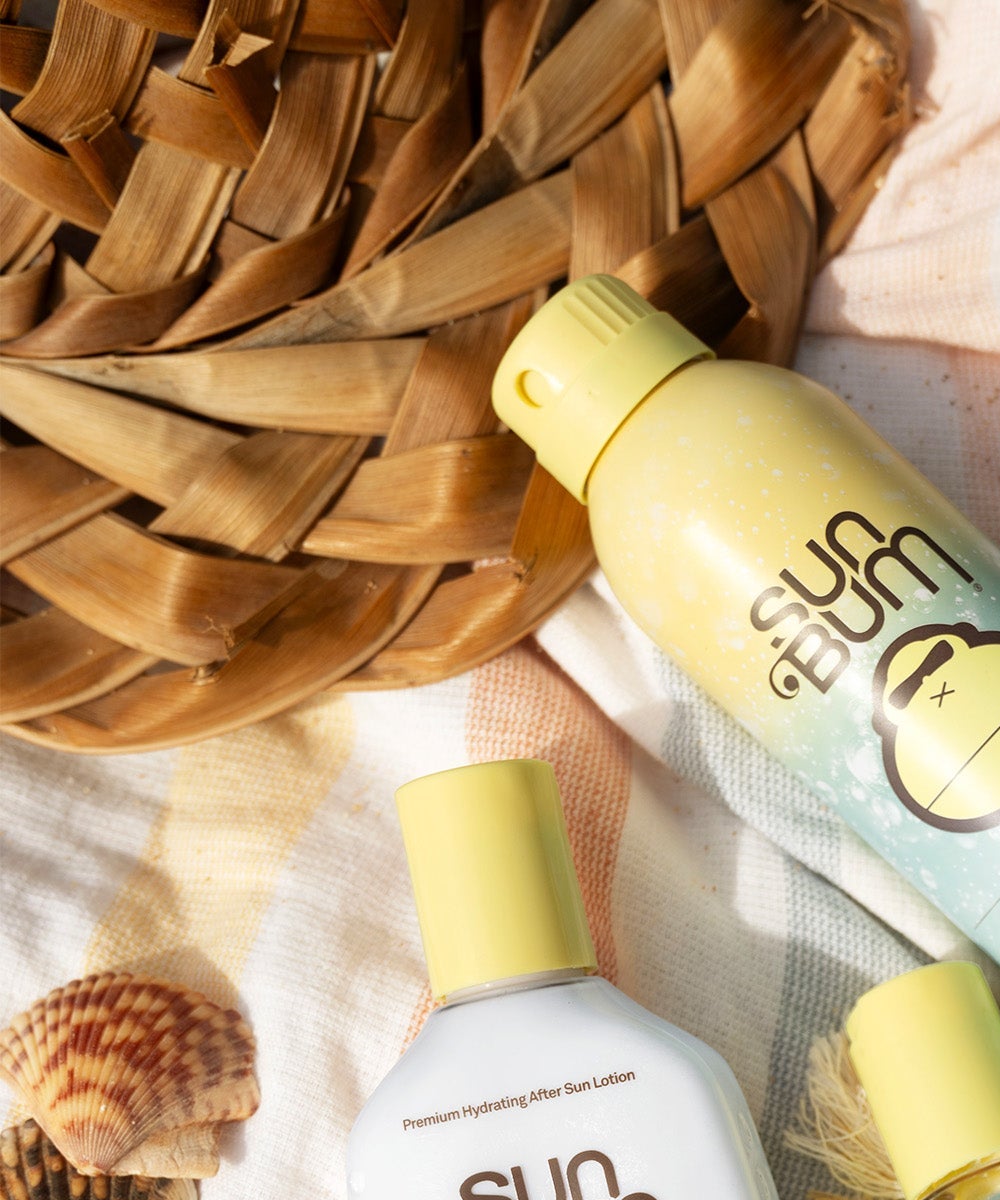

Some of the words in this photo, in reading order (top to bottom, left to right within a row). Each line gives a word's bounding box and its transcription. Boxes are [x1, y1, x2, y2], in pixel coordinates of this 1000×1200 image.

[402, 1109, 461, 1132] Premium
[461, 1094, 529, 1120] Hydrating
[528, 1086, 563, 1104] After
[563, 1080, 592, 1096] Sun
[592, 1070, 636, 1089] Lotion
